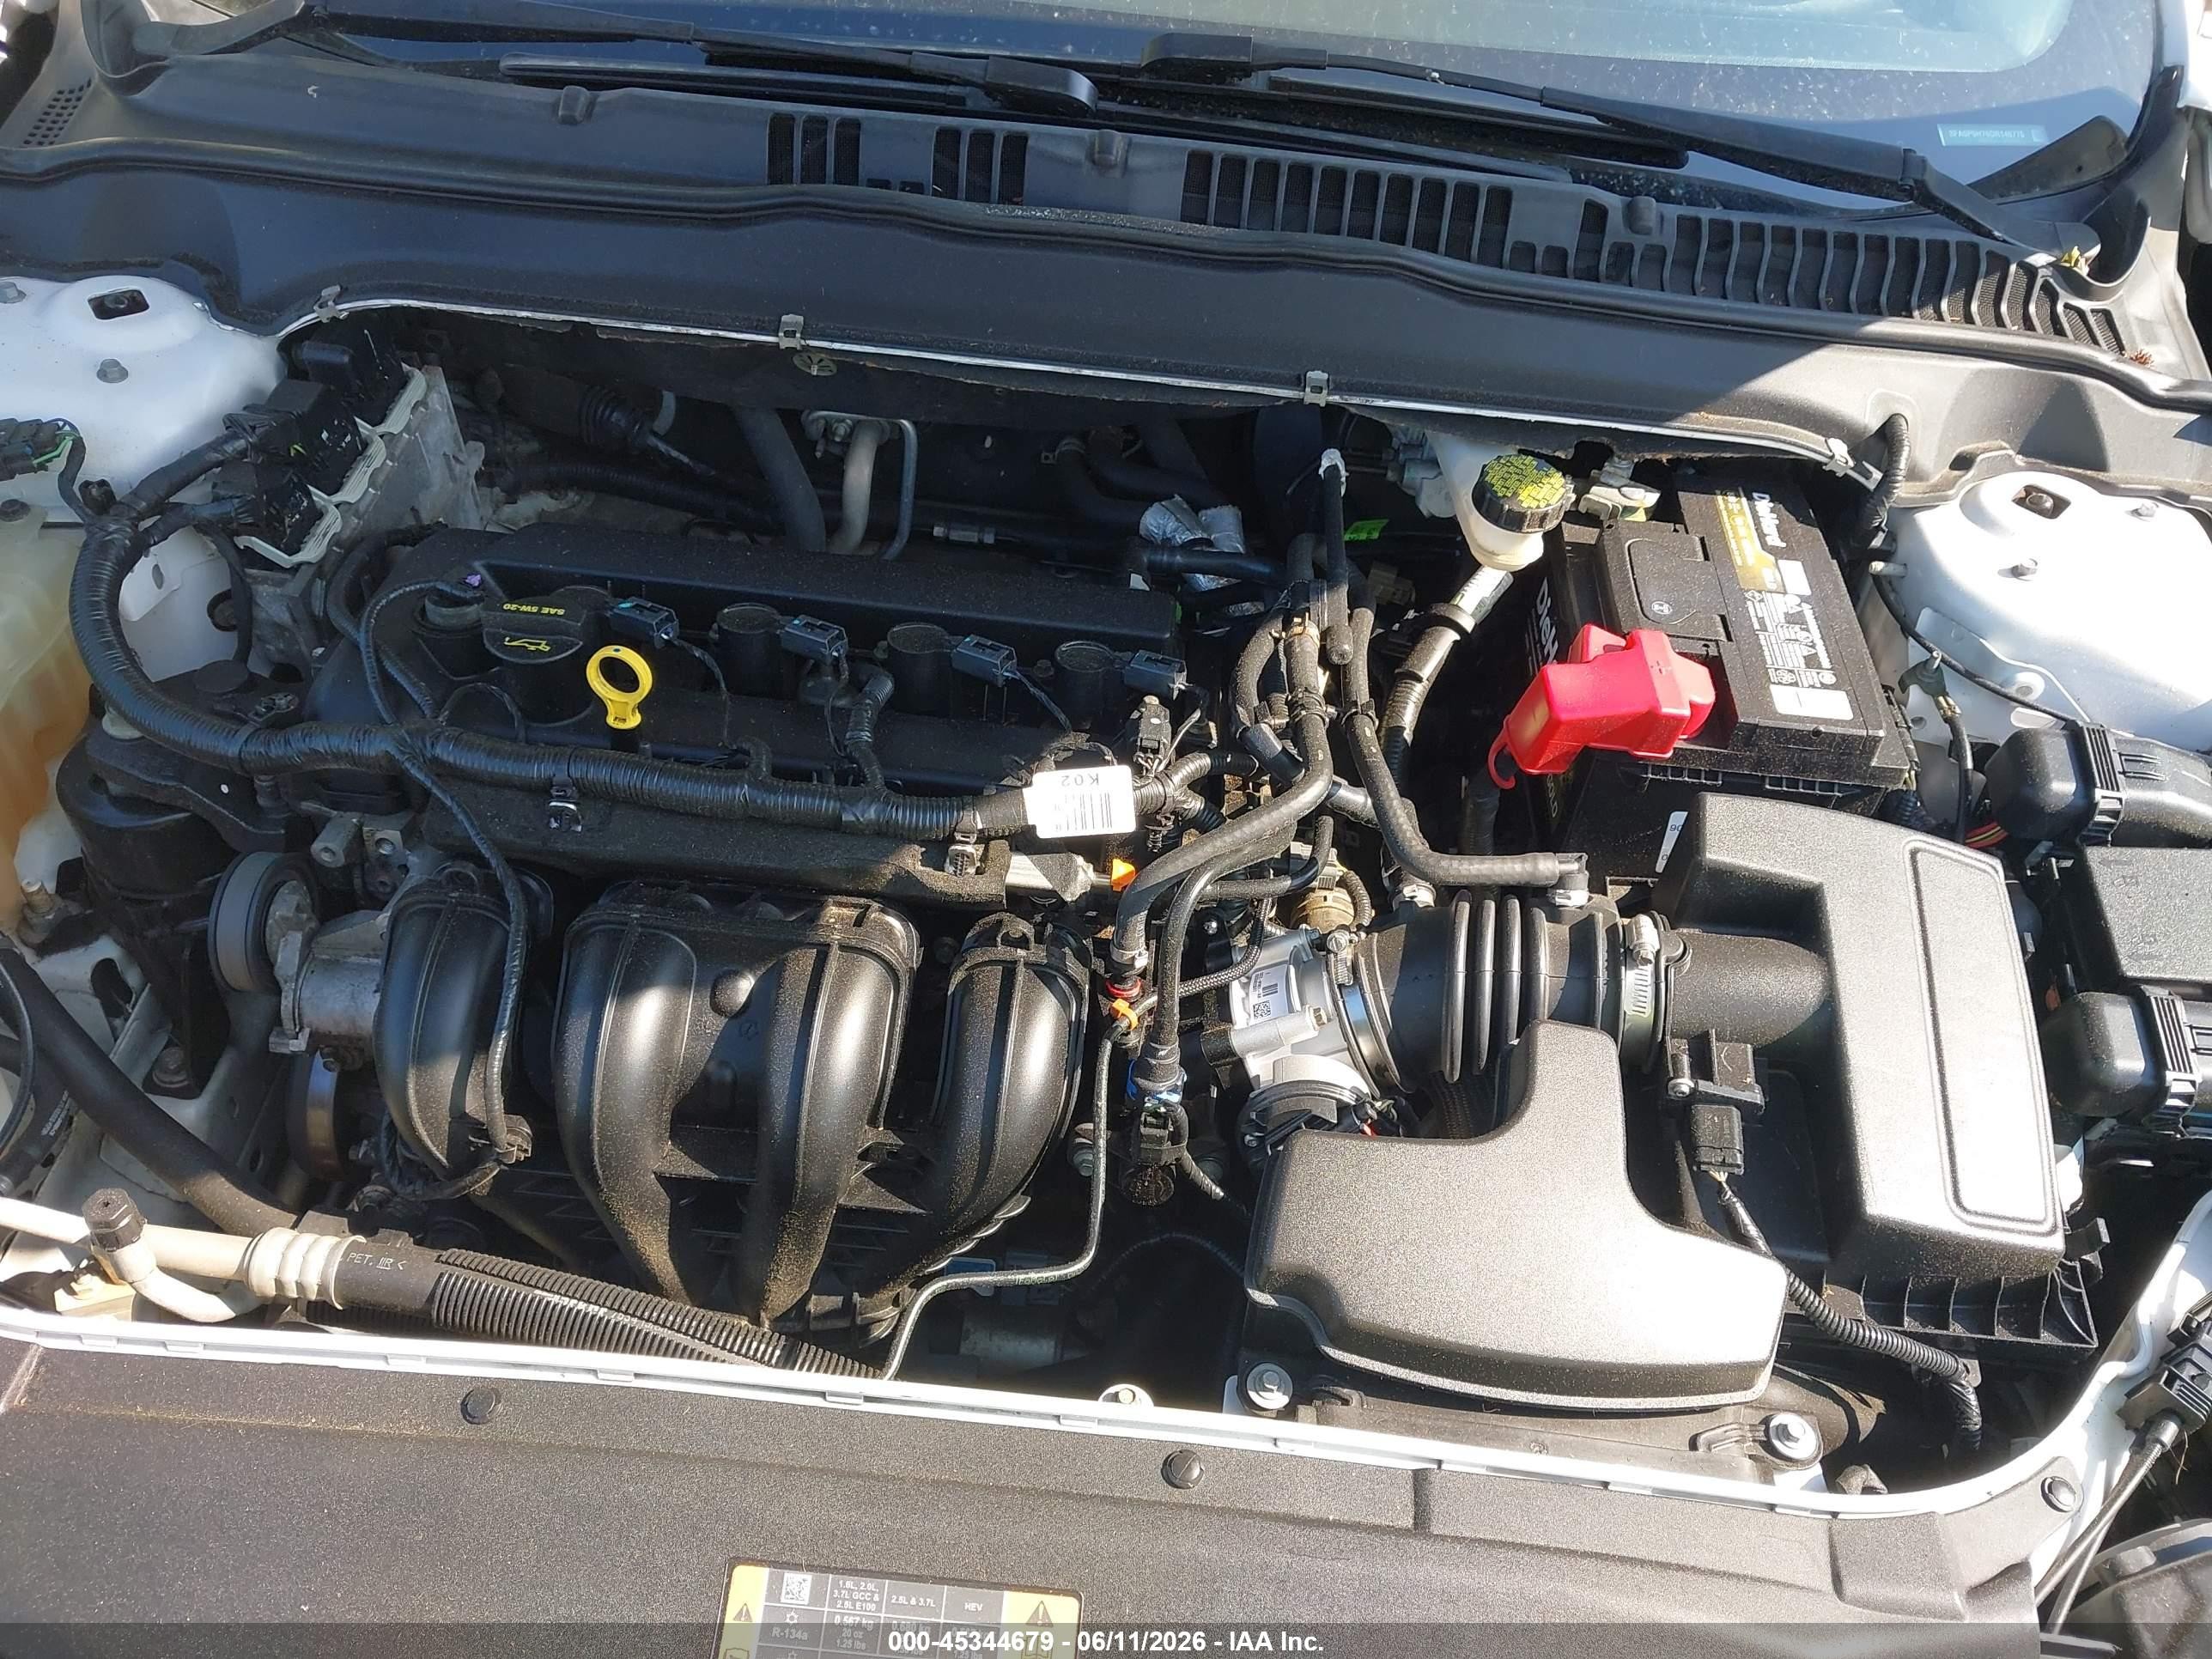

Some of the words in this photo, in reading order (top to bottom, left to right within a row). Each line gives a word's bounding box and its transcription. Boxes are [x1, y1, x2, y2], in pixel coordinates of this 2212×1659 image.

[503, 603, 538, 612] 5W-20
[541, 606, 566, 615] SAE
[1536, 577, 1559, 664] DieH
[1547, 773, 1558, 817] GOLD
[833, 1589, 850, 1599] 3.7L
[853, 1591, 872, 1600] GCC
[890, 1595, 908, 1605] 2.5L
[910, 1597, 916, 1606] &
[919, 1598, 936, 1607] 3.7L
[856, 1602, 876, 1612] E100
[964, 1602, 983, 1612] HEV
[862, 1619, 874, 1631] kg
[771, 1627, 808, 1641] R-134a
[842, 1628, 852, 1638] 20
[853, 1631, 864, 1639] oz
[836, 1638, 853, 1649] 1.25
[854, 1640, 866, 1650] lbs
